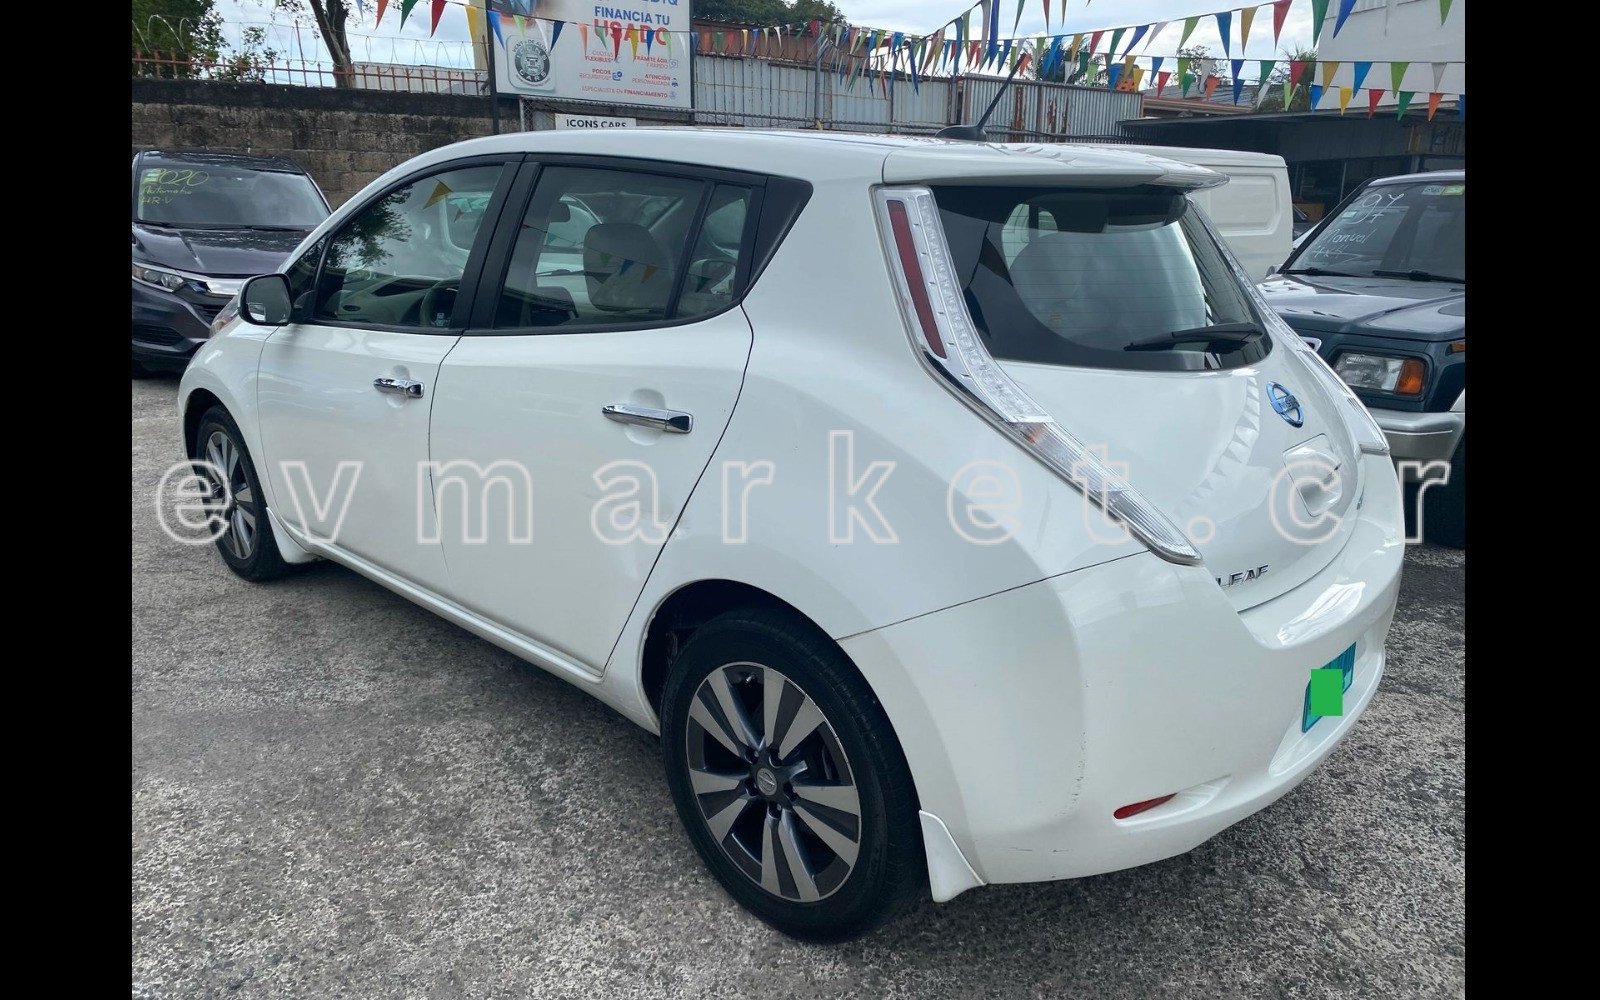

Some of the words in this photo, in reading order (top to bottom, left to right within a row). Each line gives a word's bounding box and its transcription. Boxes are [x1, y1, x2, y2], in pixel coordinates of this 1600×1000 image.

[594, 6, 653, 23] FINANCIA
[655, 14, 670, 26] TU
[512, 40, 527, 53] VENT
[519, 69, 547, 81] CARS
[624, 88, 668, 98] FINANCIAMIENTO
[566, 118, 599, 128] ICONS
[1215, 564, 1269, 588] LEAF
